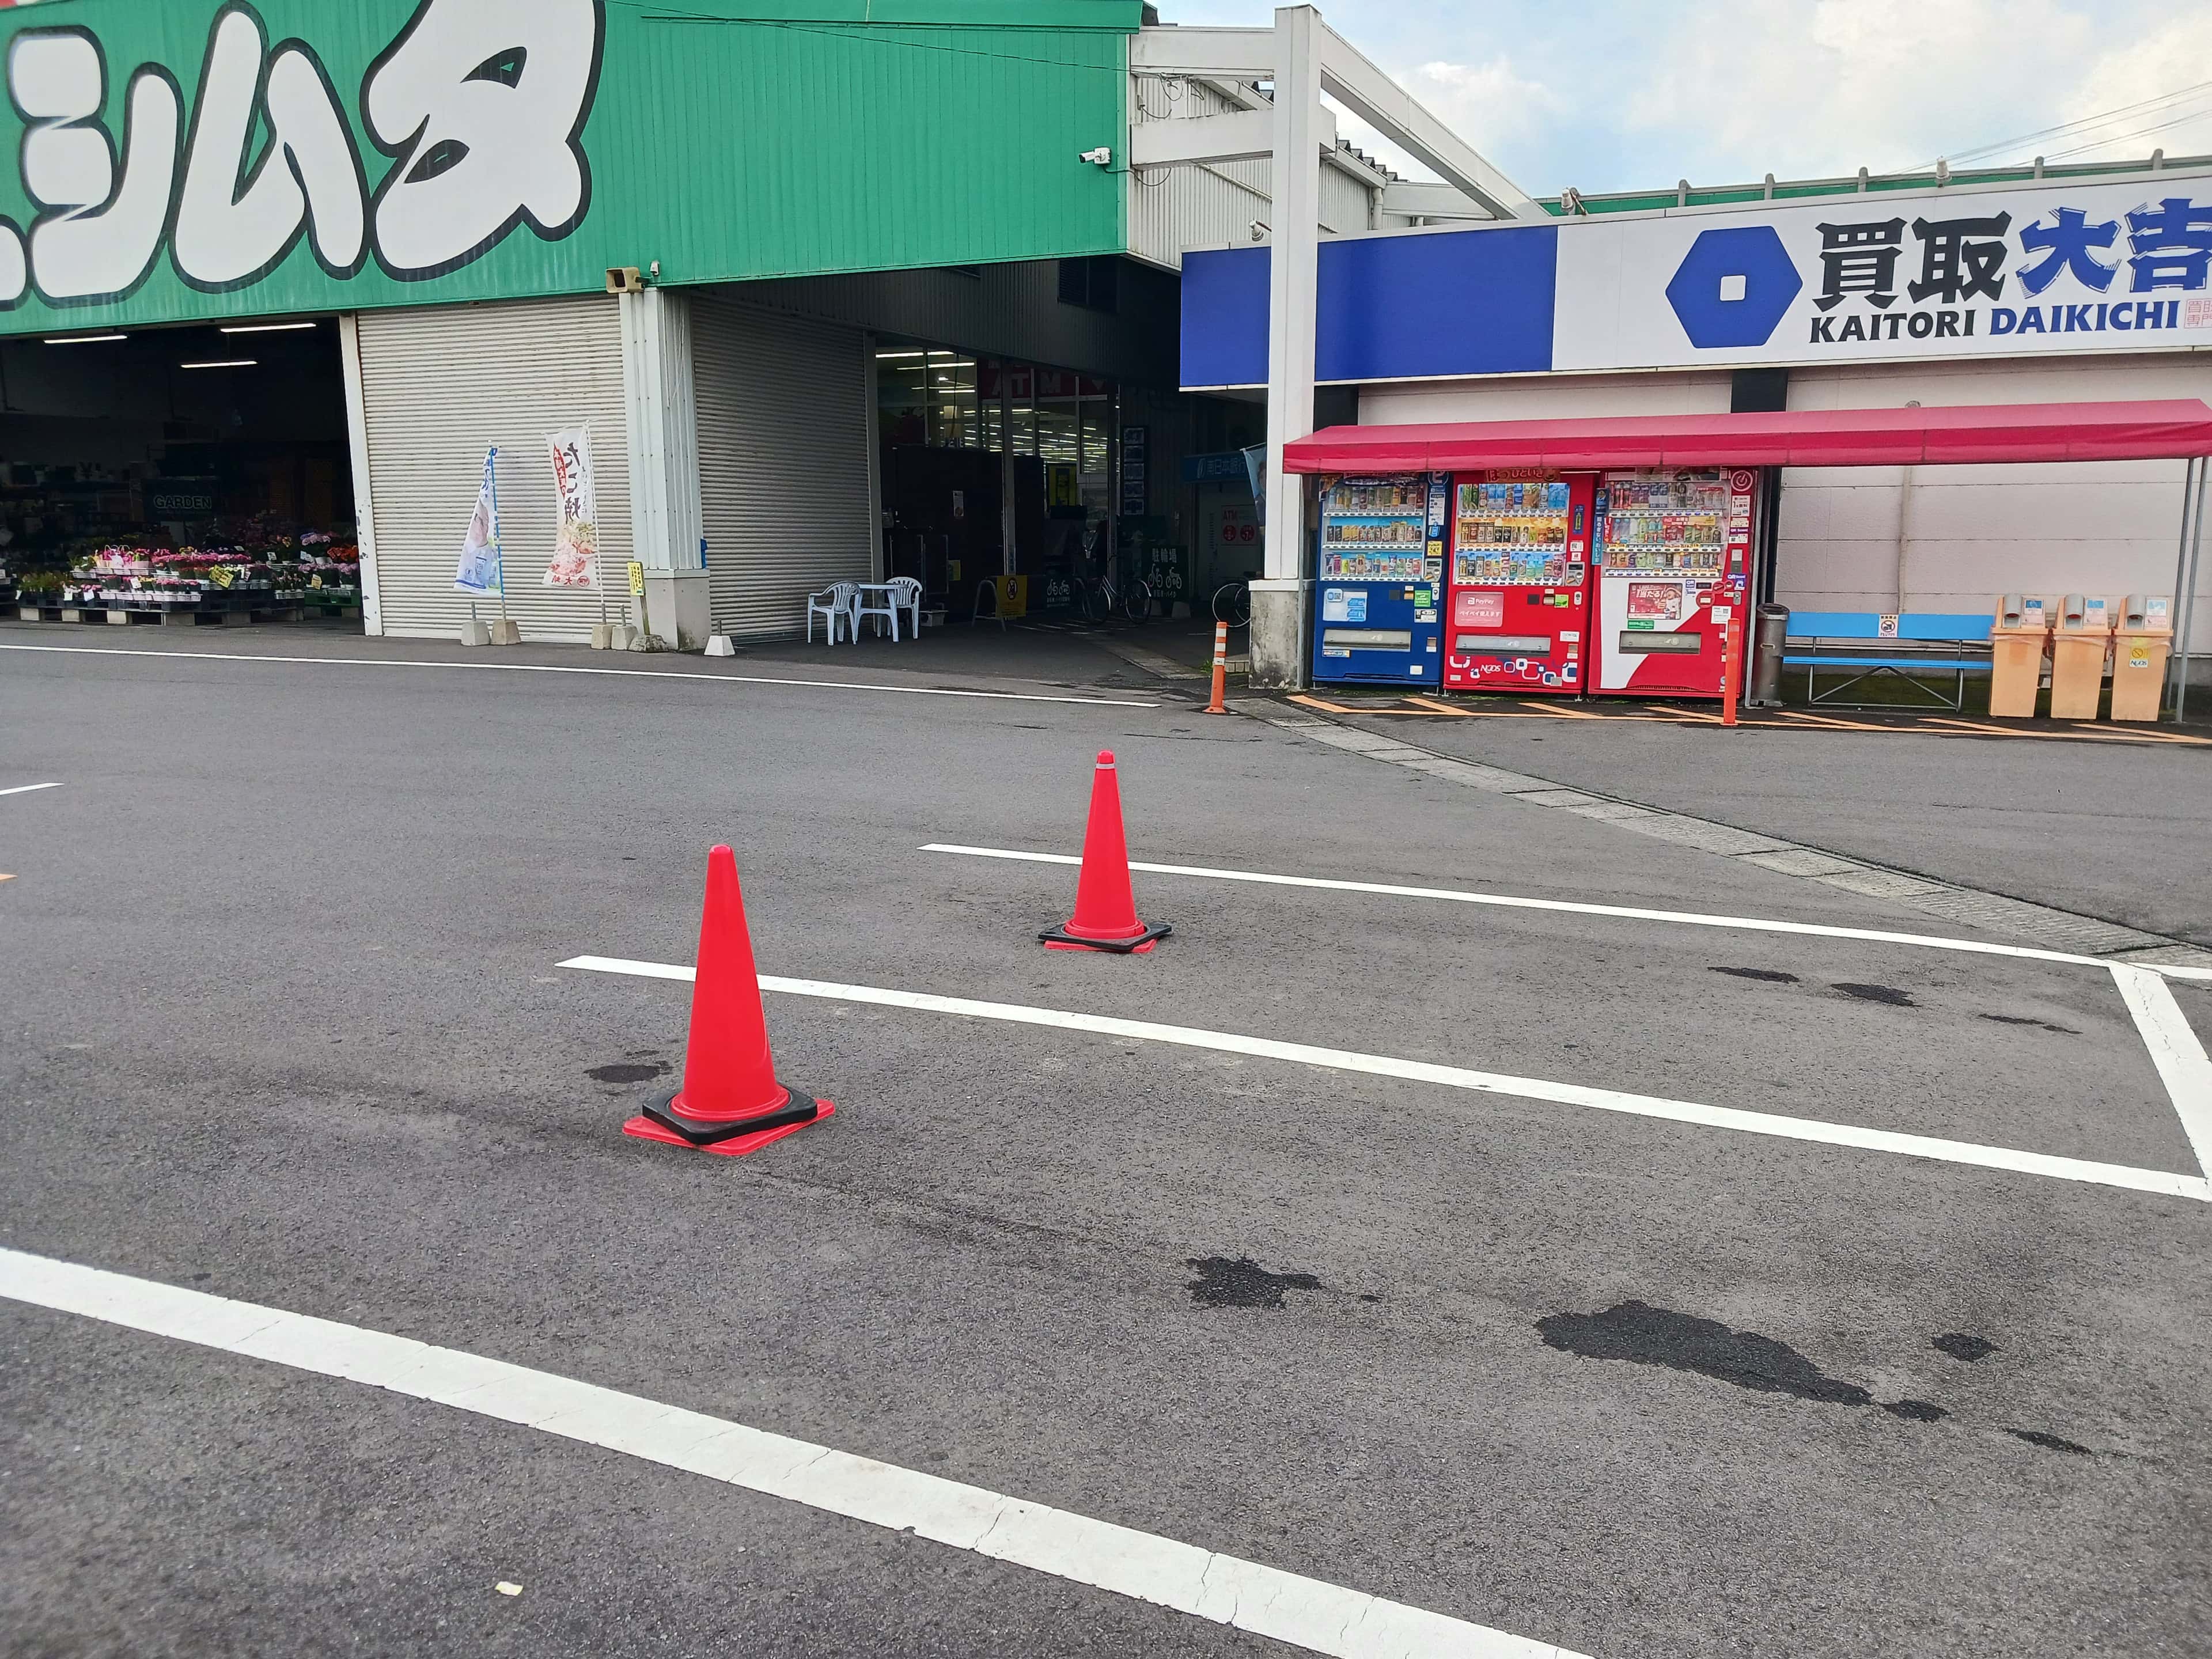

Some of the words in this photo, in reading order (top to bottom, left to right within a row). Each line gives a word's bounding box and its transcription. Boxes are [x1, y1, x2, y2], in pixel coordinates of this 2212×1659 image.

[0, 0, 604, 310] シムタ
[1812, 198, 2212, 310] 買取大吉
[1809, 309, 1975, 343] KAITORI
[1990, 301, 2180, 336] DAIKICHI
[153, 495, 213, 509] GARDEN
